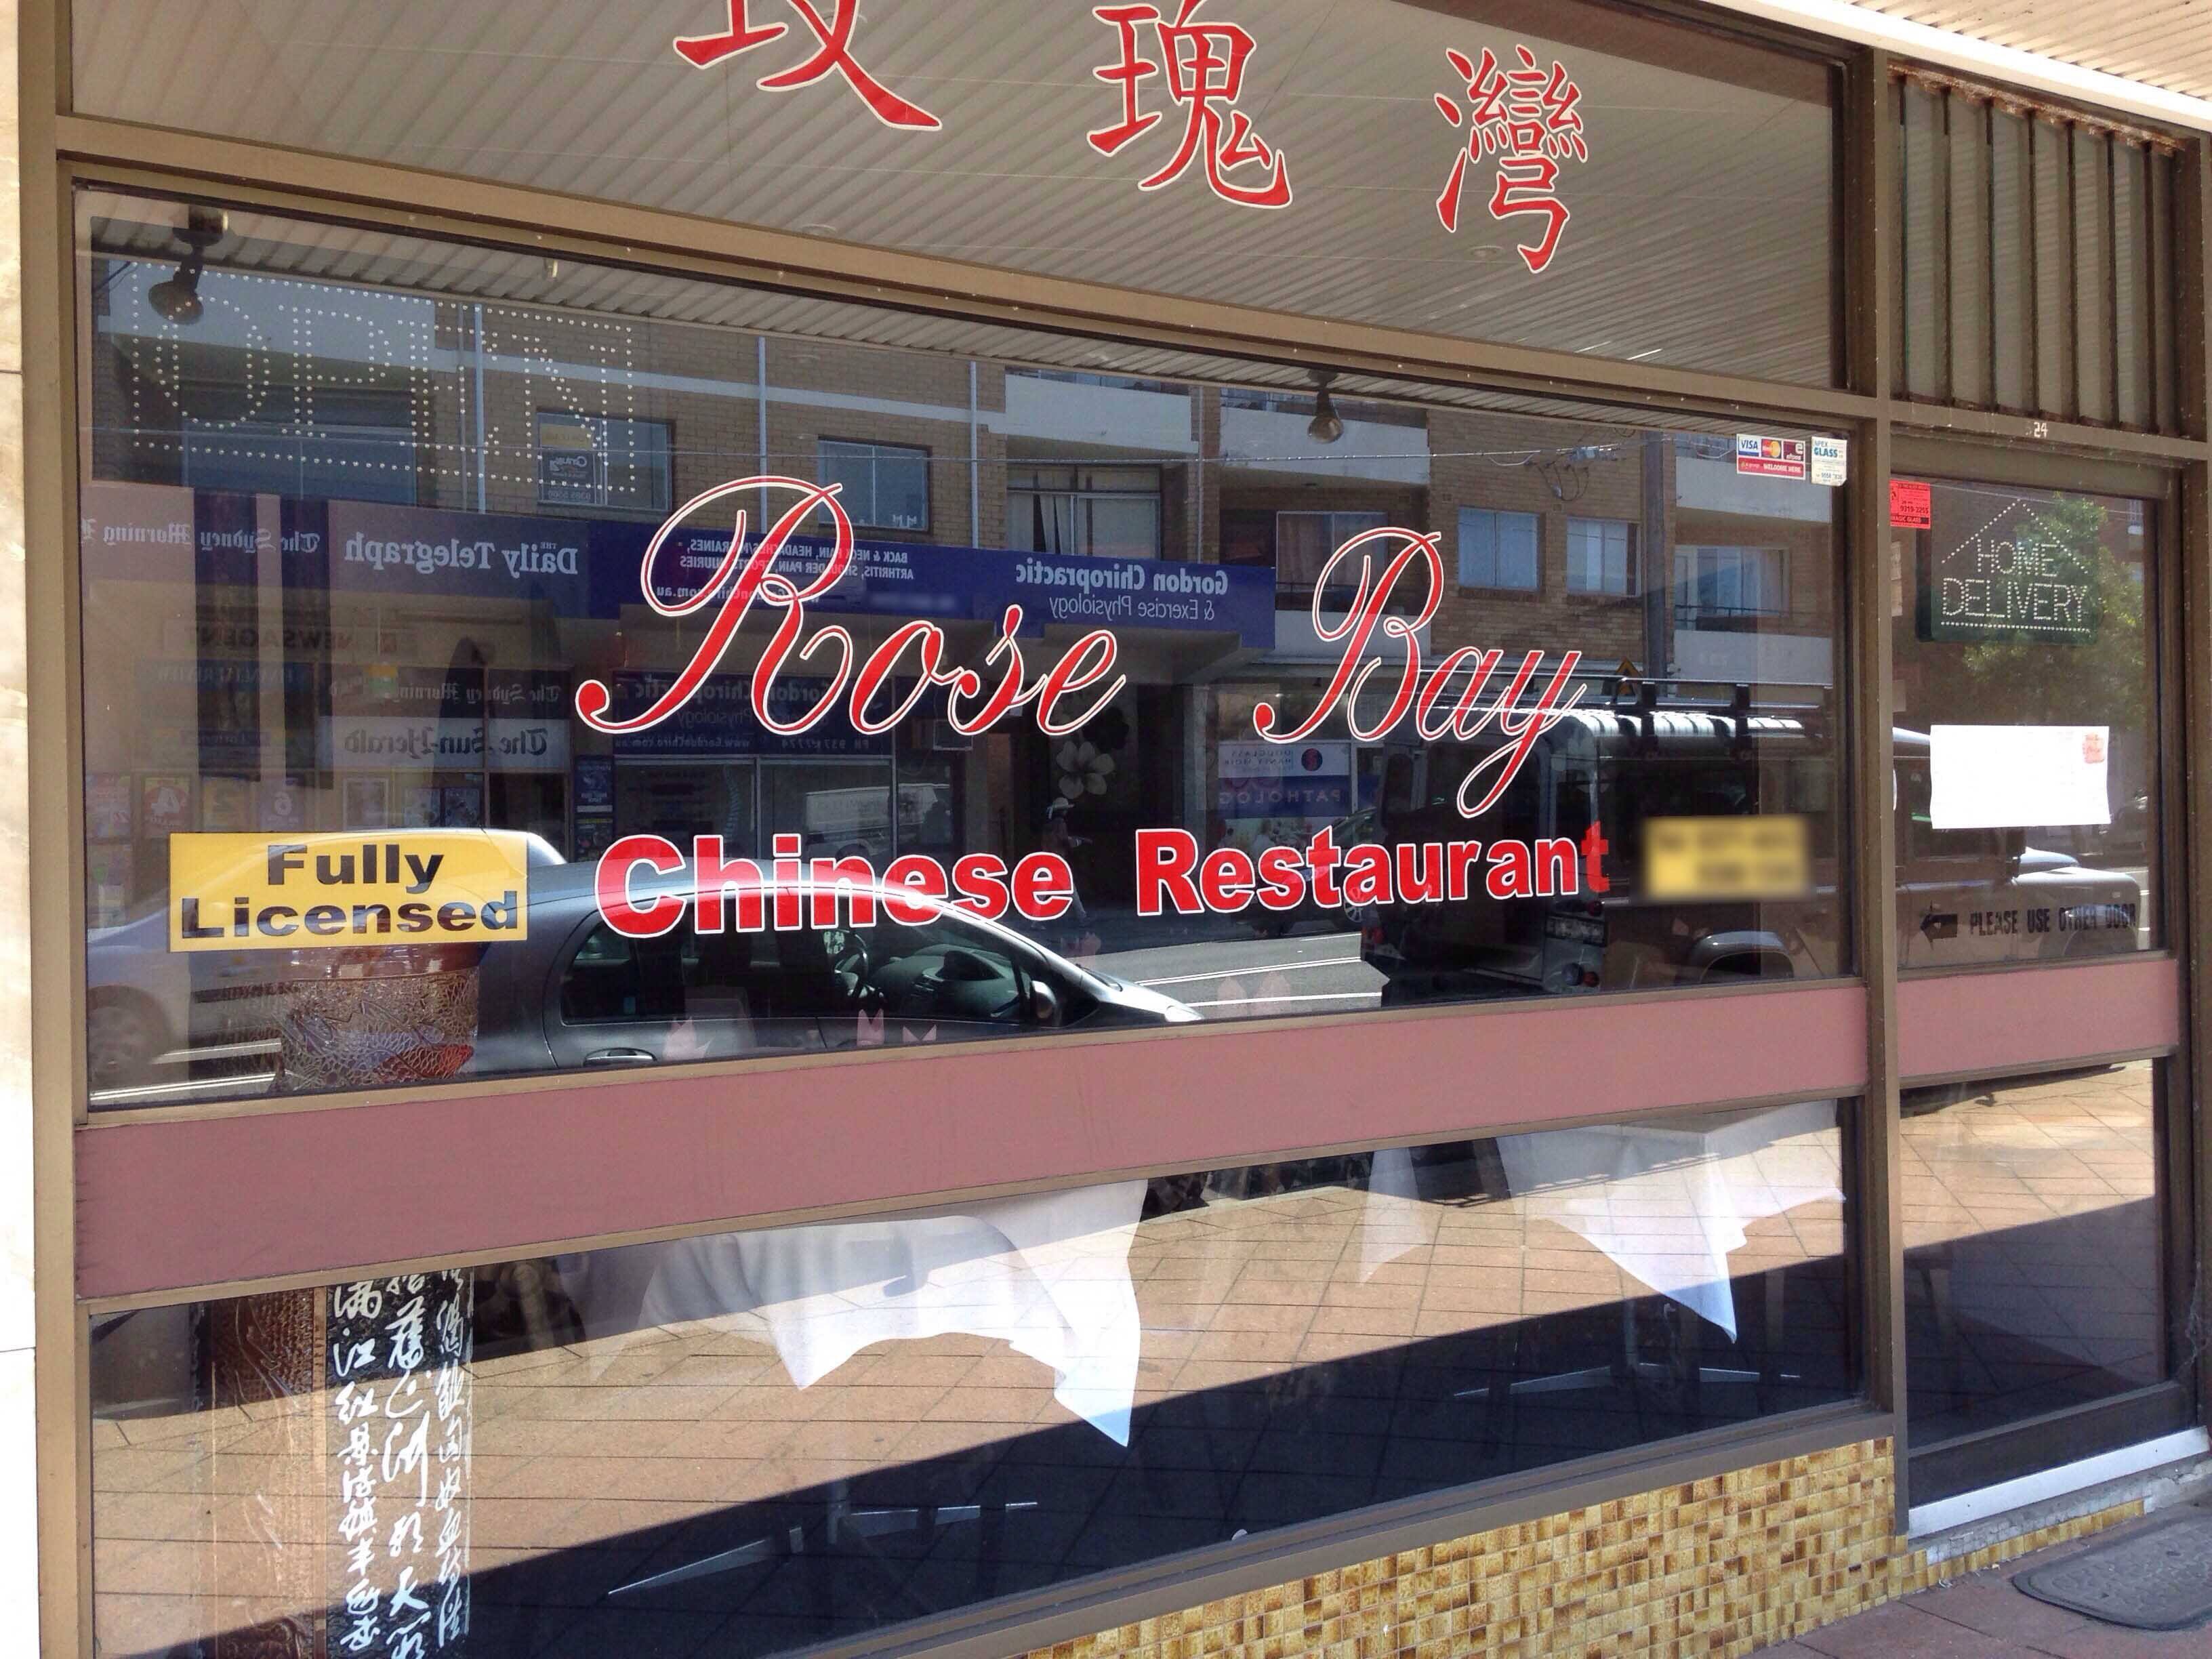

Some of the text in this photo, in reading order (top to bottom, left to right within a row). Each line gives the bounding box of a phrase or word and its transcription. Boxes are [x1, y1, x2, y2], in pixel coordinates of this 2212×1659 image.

[1741, 440, 1758, 450] VISA
[2034, 422, 2048, 438] 24
[1814, 447, 1838, 458] GLASS
[1978, 539, 2057, 577] HOME
[1942, 577, 2088, 622] DELIVERY
[575, 474, 1588, 819] Rose Bay
[268, 844, 444, 893] Fully
[595, 833, 1074, 939] Chinese
[1136, 819, 1610, 917] Restaurant
[181, 890, 518, 939] Licensed
[1970, 910, 2018, 937] PLEASE
[2026, 908, 2050, 933] USE
